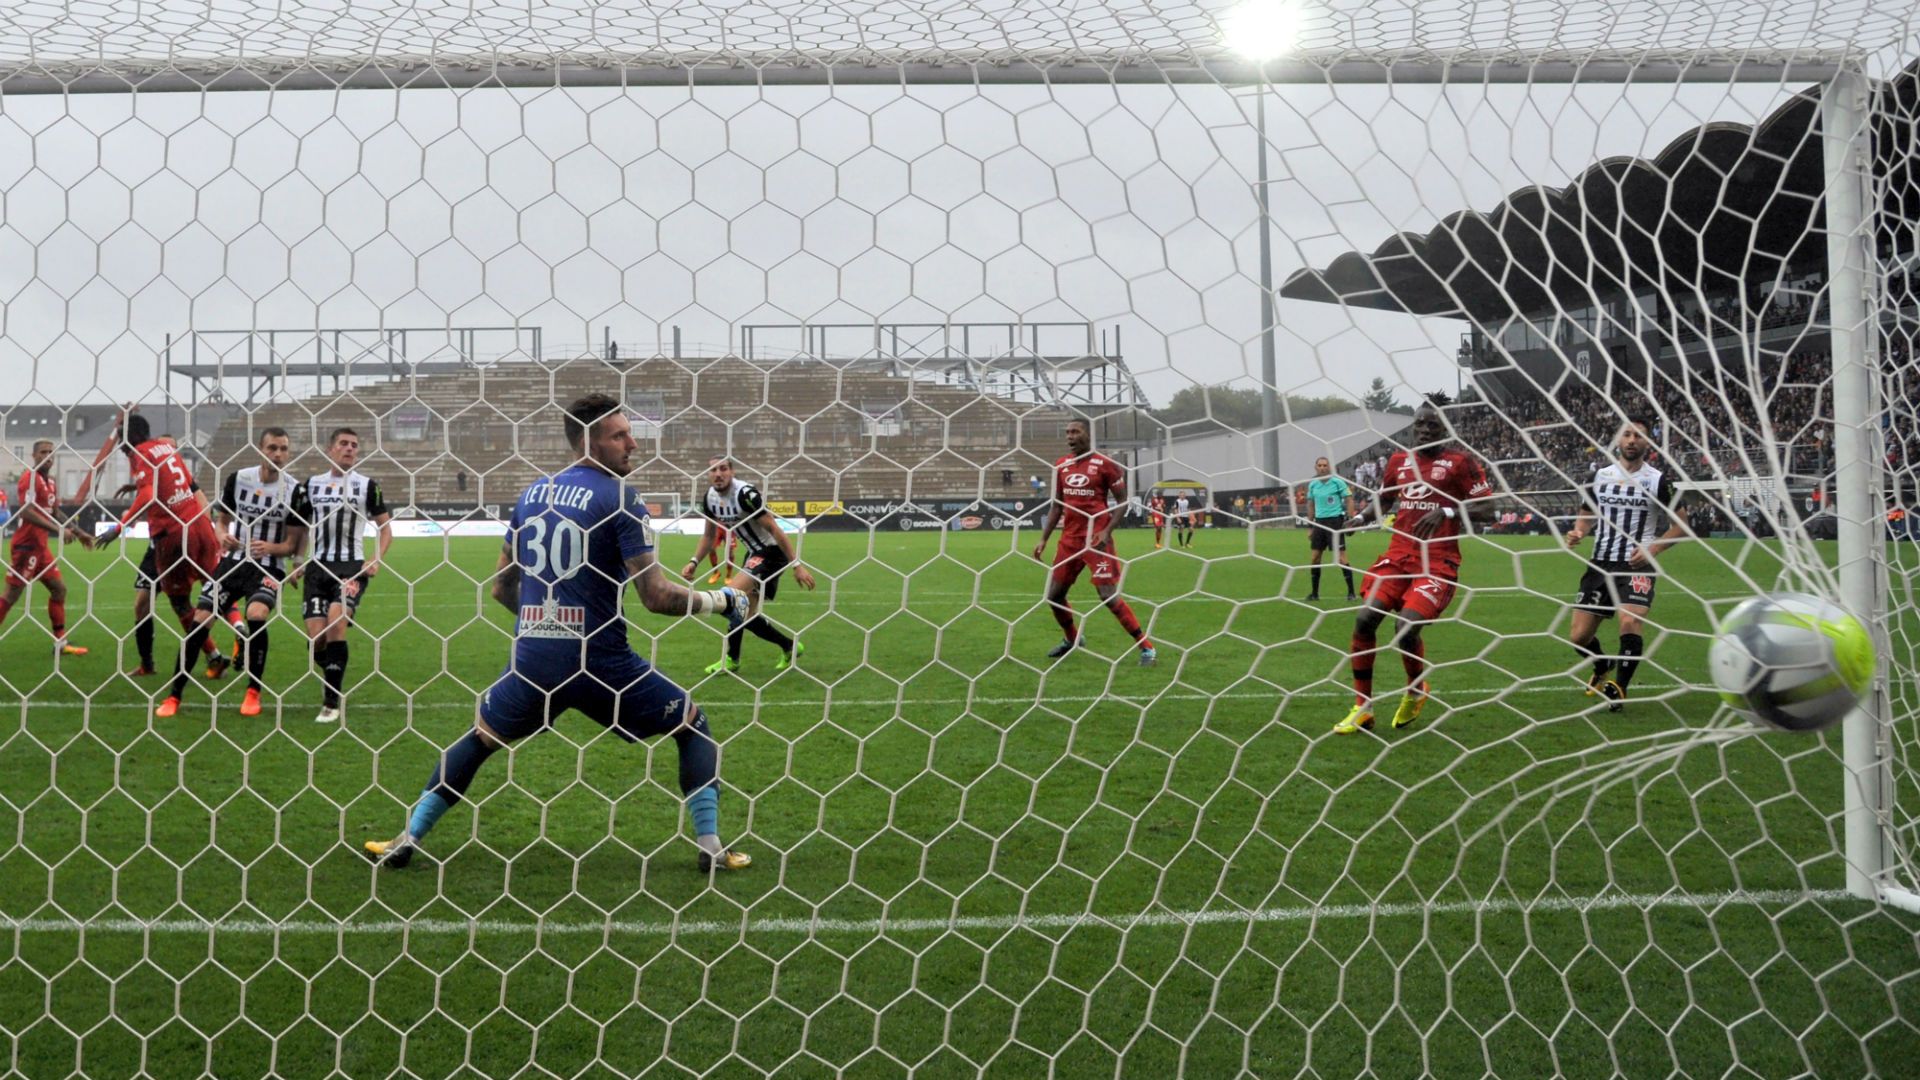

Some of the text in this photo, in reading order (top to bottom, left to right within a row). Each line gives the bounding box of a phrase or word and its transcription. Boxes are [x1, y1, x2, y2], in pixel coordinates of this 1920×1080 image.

[167, 456, 186, 486] 5
[524, 483, 594, 512] LETELLIER
[1063, 488, 1095, 496] HYUNDAI
[849, 501, 916, 514] CONNIVENCE
[1400, 501, 1440, 511] HYUNDAI
[1599, 495, 1649, 508] SCANIA
[238, 503, 283, 518] SCANIA
[524, 516, 582, 580] 30
[28, 555, 37, 570] 9
[1588, 591, 1601, 606] 3
[520, 622, 583, 632] LA BOUCHERIE
